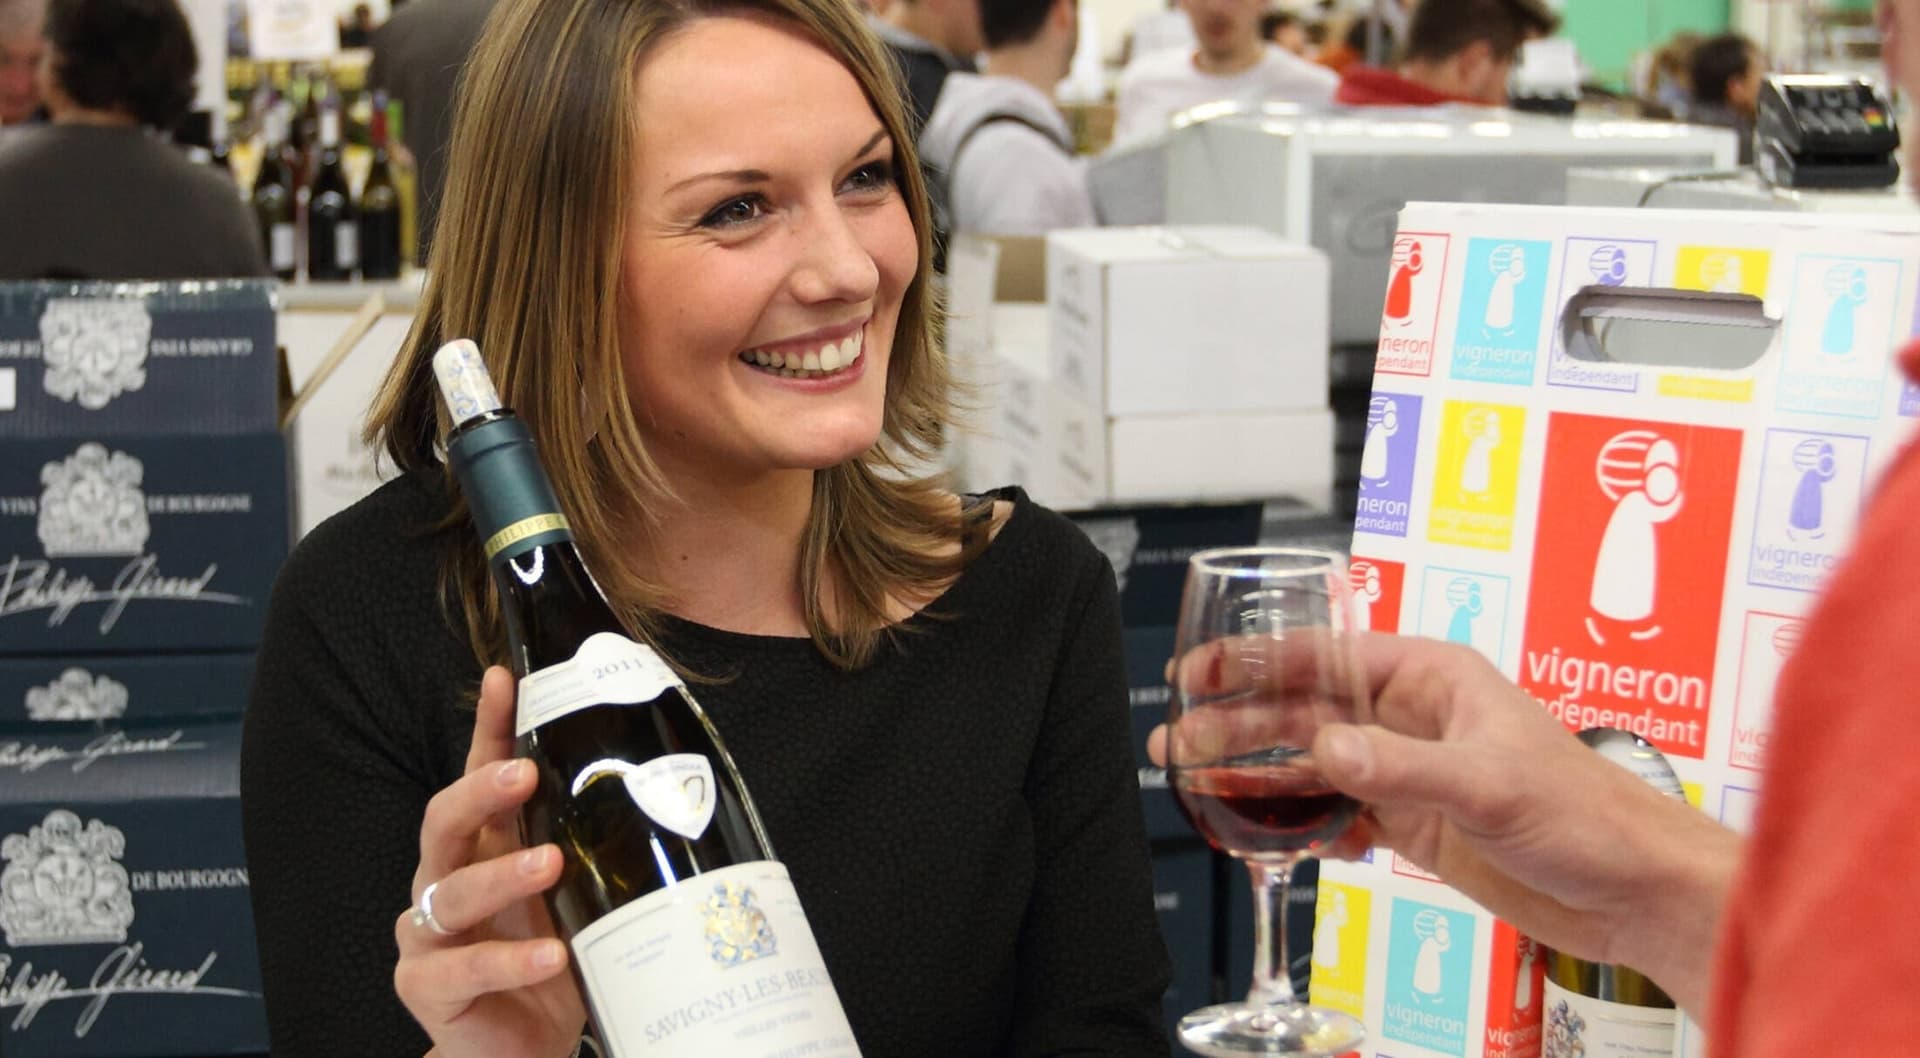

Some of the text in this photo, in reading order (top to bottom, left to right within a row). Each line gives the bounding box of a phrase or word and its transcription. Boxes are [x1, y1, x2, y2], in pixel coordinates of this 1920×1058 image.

[1381, 337, 1429, 354] neron
[1378, 356, 1427, 370] pendant
[1357, 496, 1408, 516] neron
[1355, 515, 1405, 532] pendant
[1754, 544, 1838, 570] vignero
[591, 656, 645, 681] 2011
[1527, 646, 1706, 710] vigneron
[1524, 687, 1701, 747] dependant
[131, 867, 250, 892] DE BOURGOGN
[1386, 1002, 1465, 1035] vigneron
